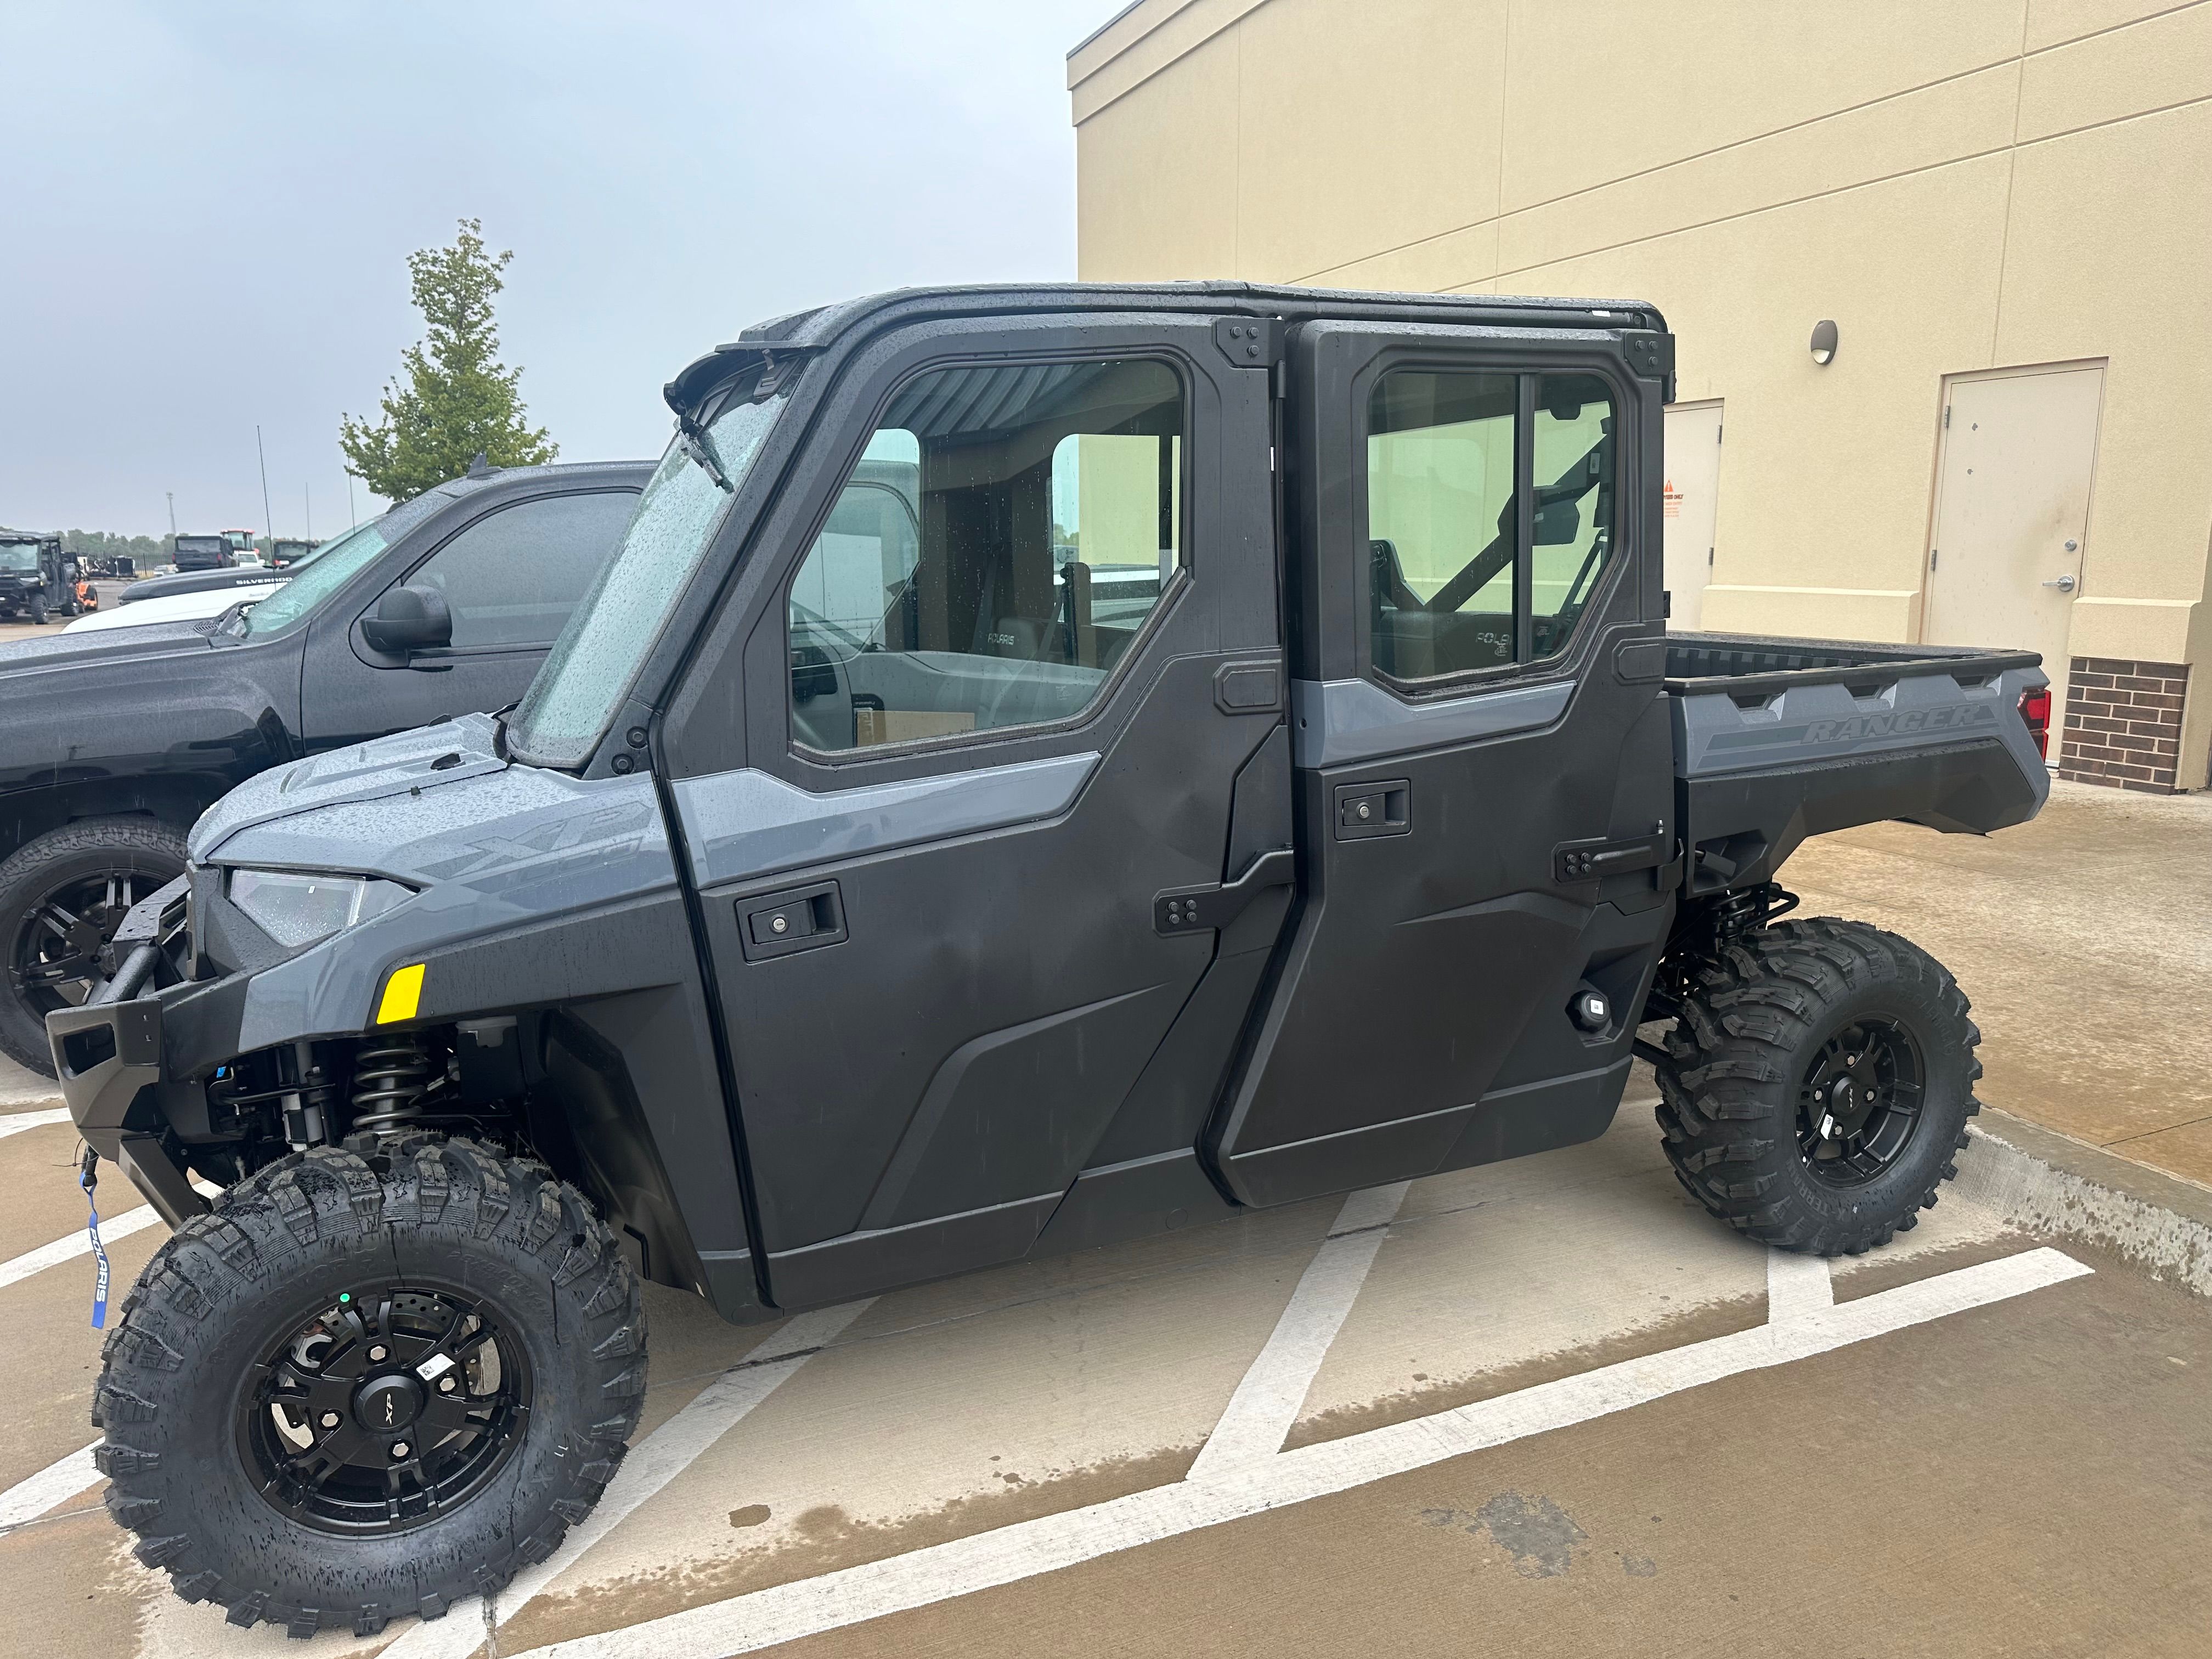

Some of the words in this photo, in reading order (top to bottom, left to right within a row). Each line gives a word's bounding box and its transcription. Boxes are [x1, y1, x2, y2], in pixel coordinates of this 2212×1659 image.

[236, 577, 293, 585] SILVERADO
[988, 633, 1014, 645] POLARIS
[1475, 632, 1513, 646] POLA
[1801, 703, 1980, 744] RANGER
[422, 800, 654, 881] XP
[89, 1227, 109, 1303] POLARIS
[385, 1393, 393, 1425] XP
